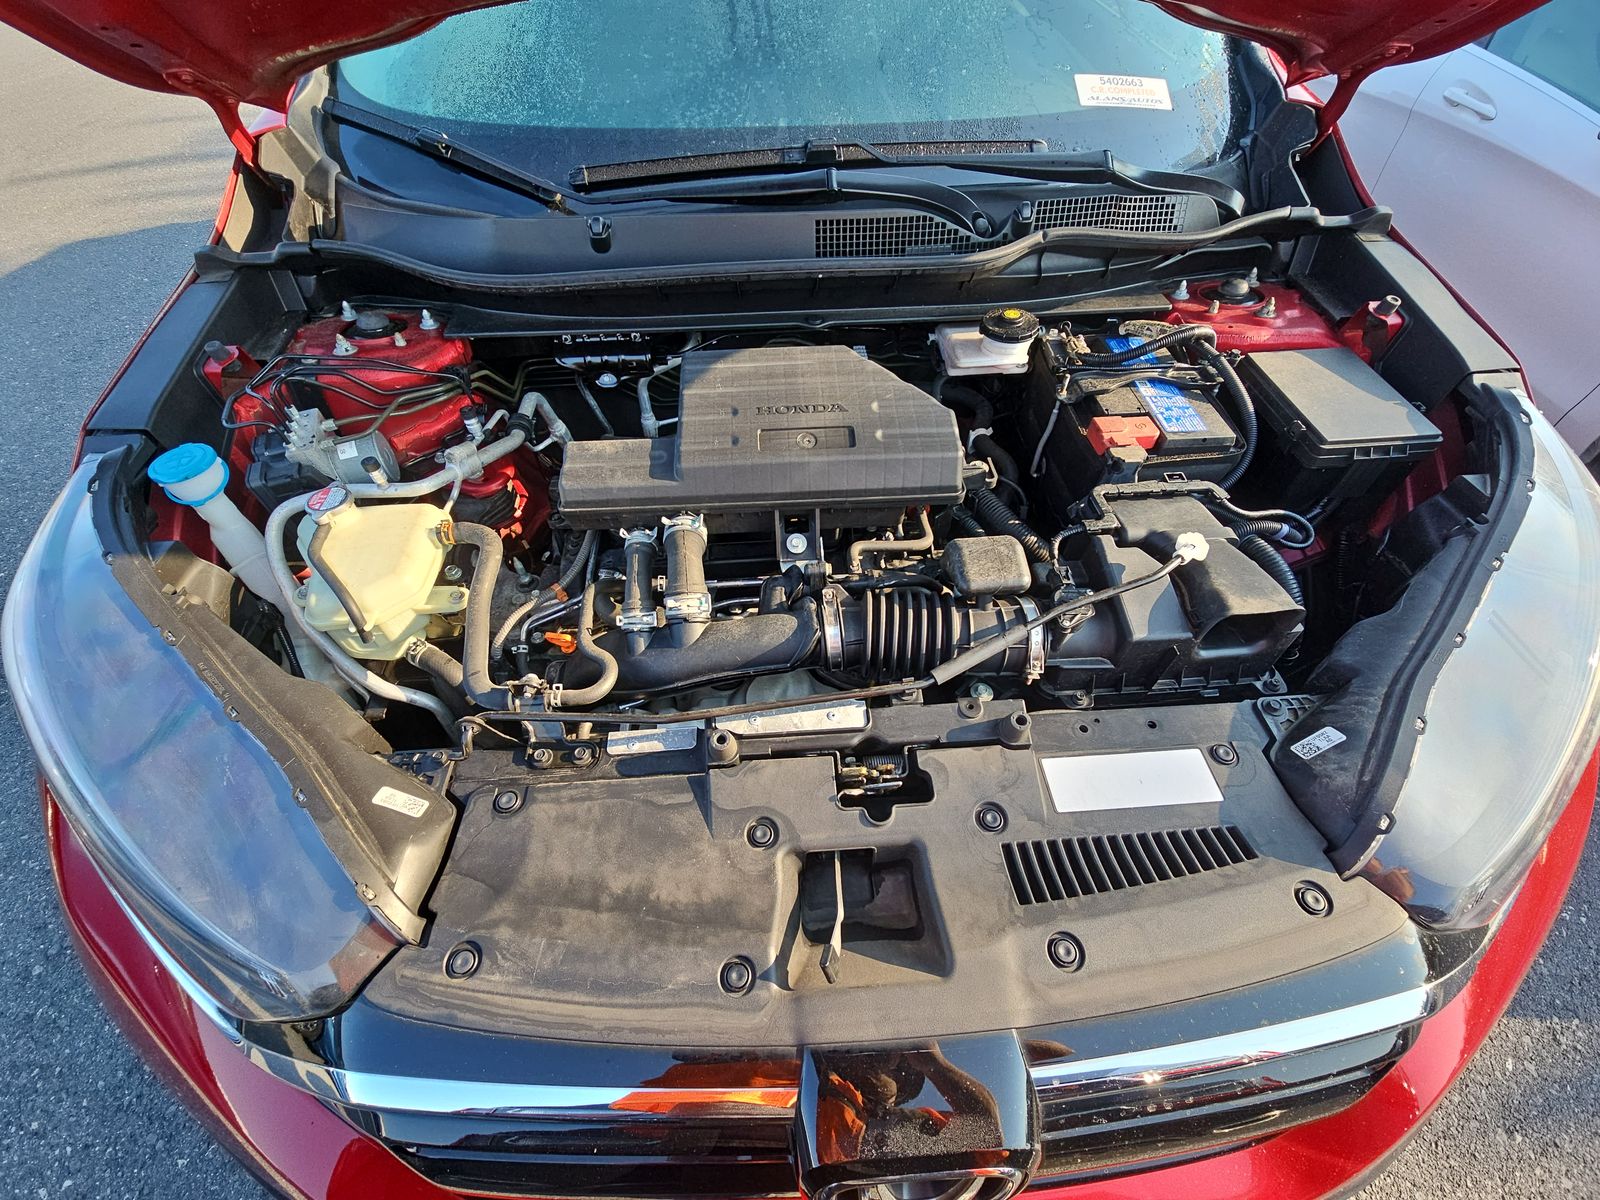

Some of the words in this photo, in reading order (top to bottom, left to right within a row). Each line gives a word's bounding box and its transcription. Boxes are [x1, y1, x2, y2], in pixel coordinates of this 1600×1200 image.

[1099, 76, 1144, 88] 5402663
[1107, 86, 1156, 96] COMPLETED
[756, 403, 849, 416] HONDA
